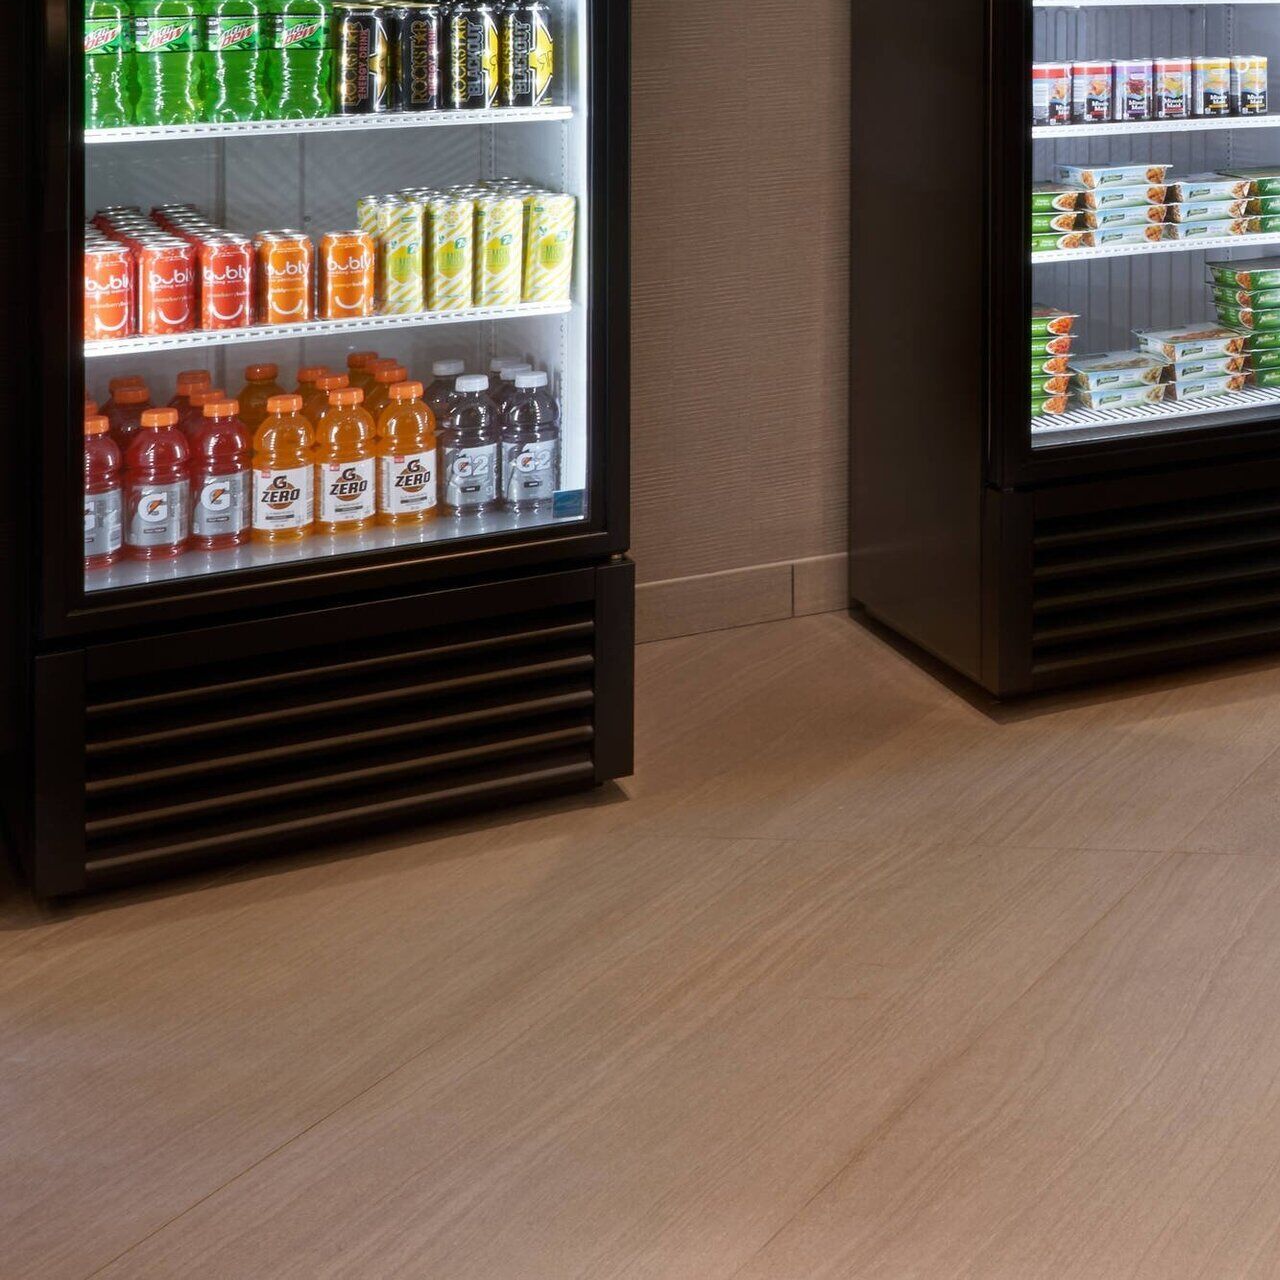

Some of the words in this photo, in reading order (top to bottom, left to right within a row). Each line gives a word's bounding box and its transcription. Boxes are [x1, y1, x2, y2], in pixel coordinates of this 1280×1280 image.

[467, 22, 484, 97] BLACKOUT
[329, 479, 368, 495] ZERO
[394, 470, 431, 488] ZERO
[261, 489, 300, 503] ZERO
